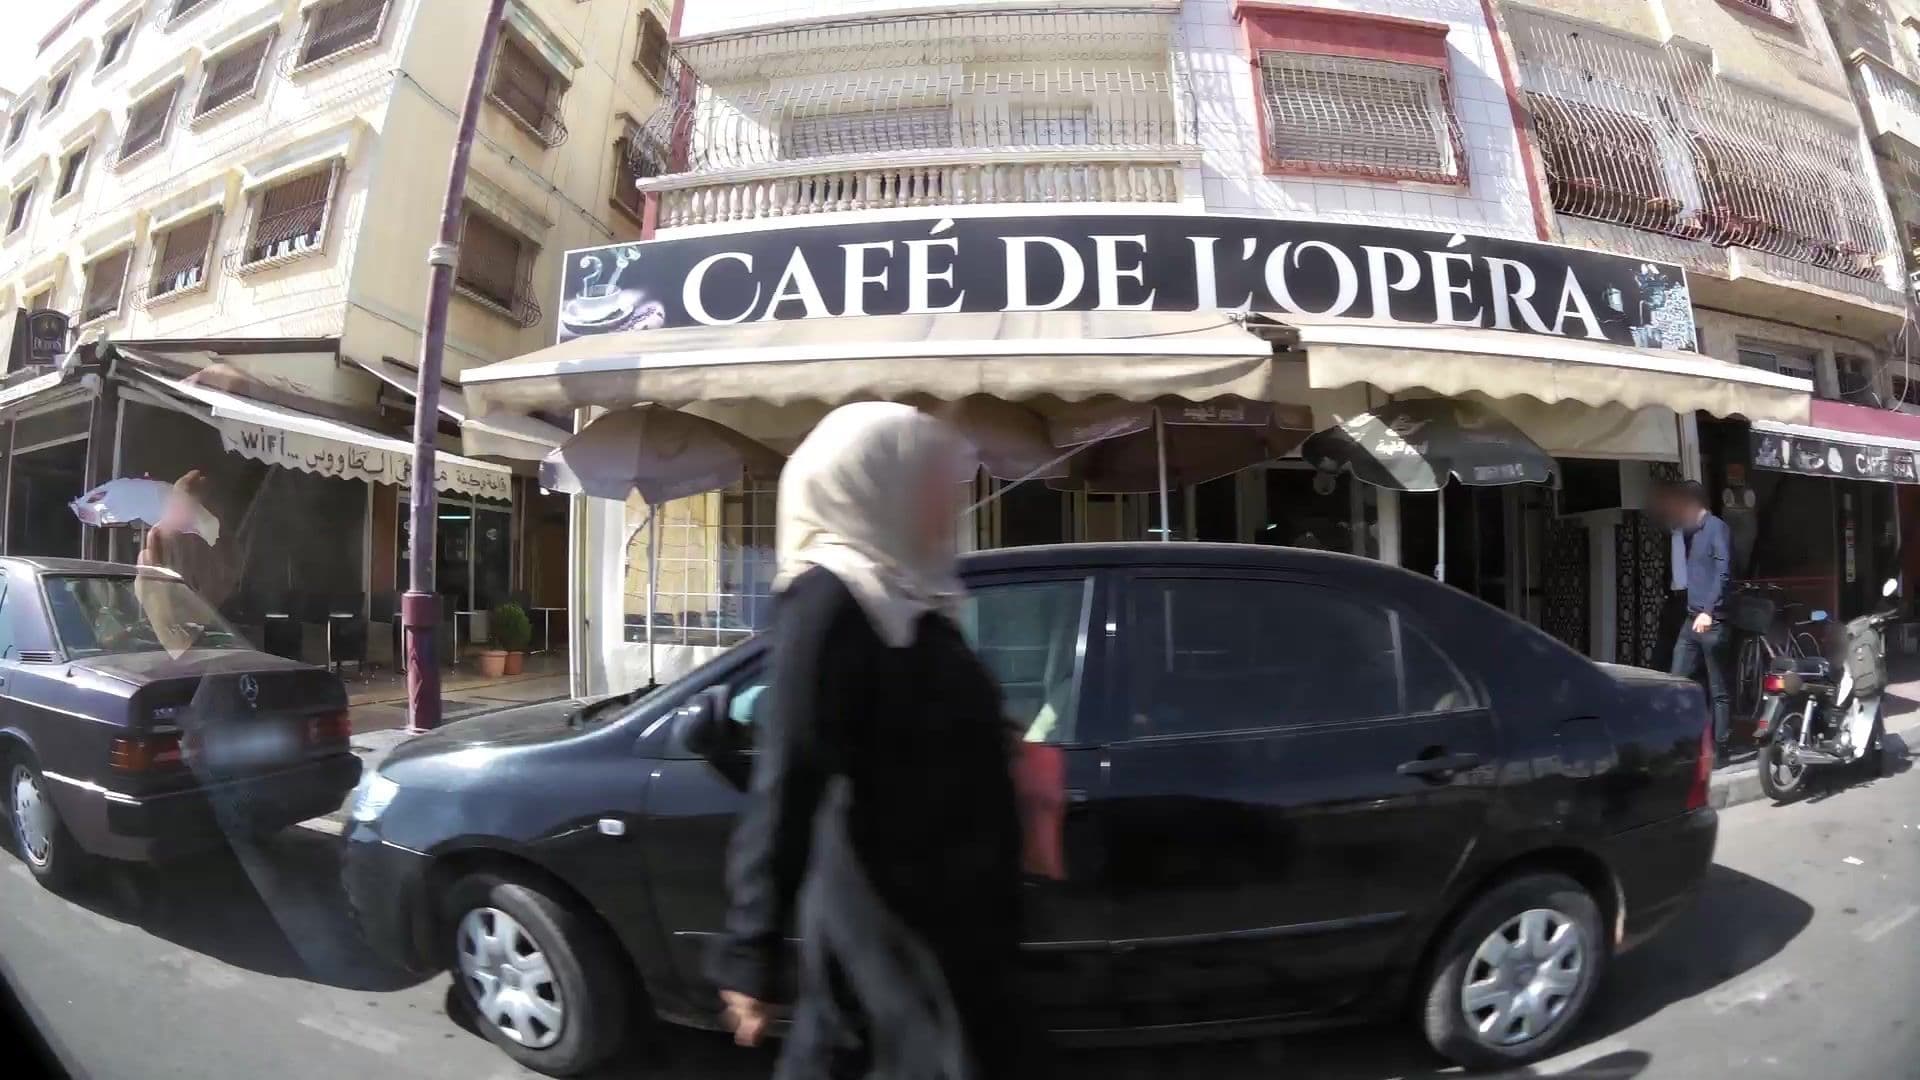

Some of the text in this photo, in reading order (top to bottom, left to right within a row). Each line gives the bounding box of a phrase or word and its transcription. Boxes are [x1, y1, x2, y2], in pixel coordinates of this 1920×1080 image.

[683, 218, 1610, 340] CAFÉ DE L'OPÉRA
